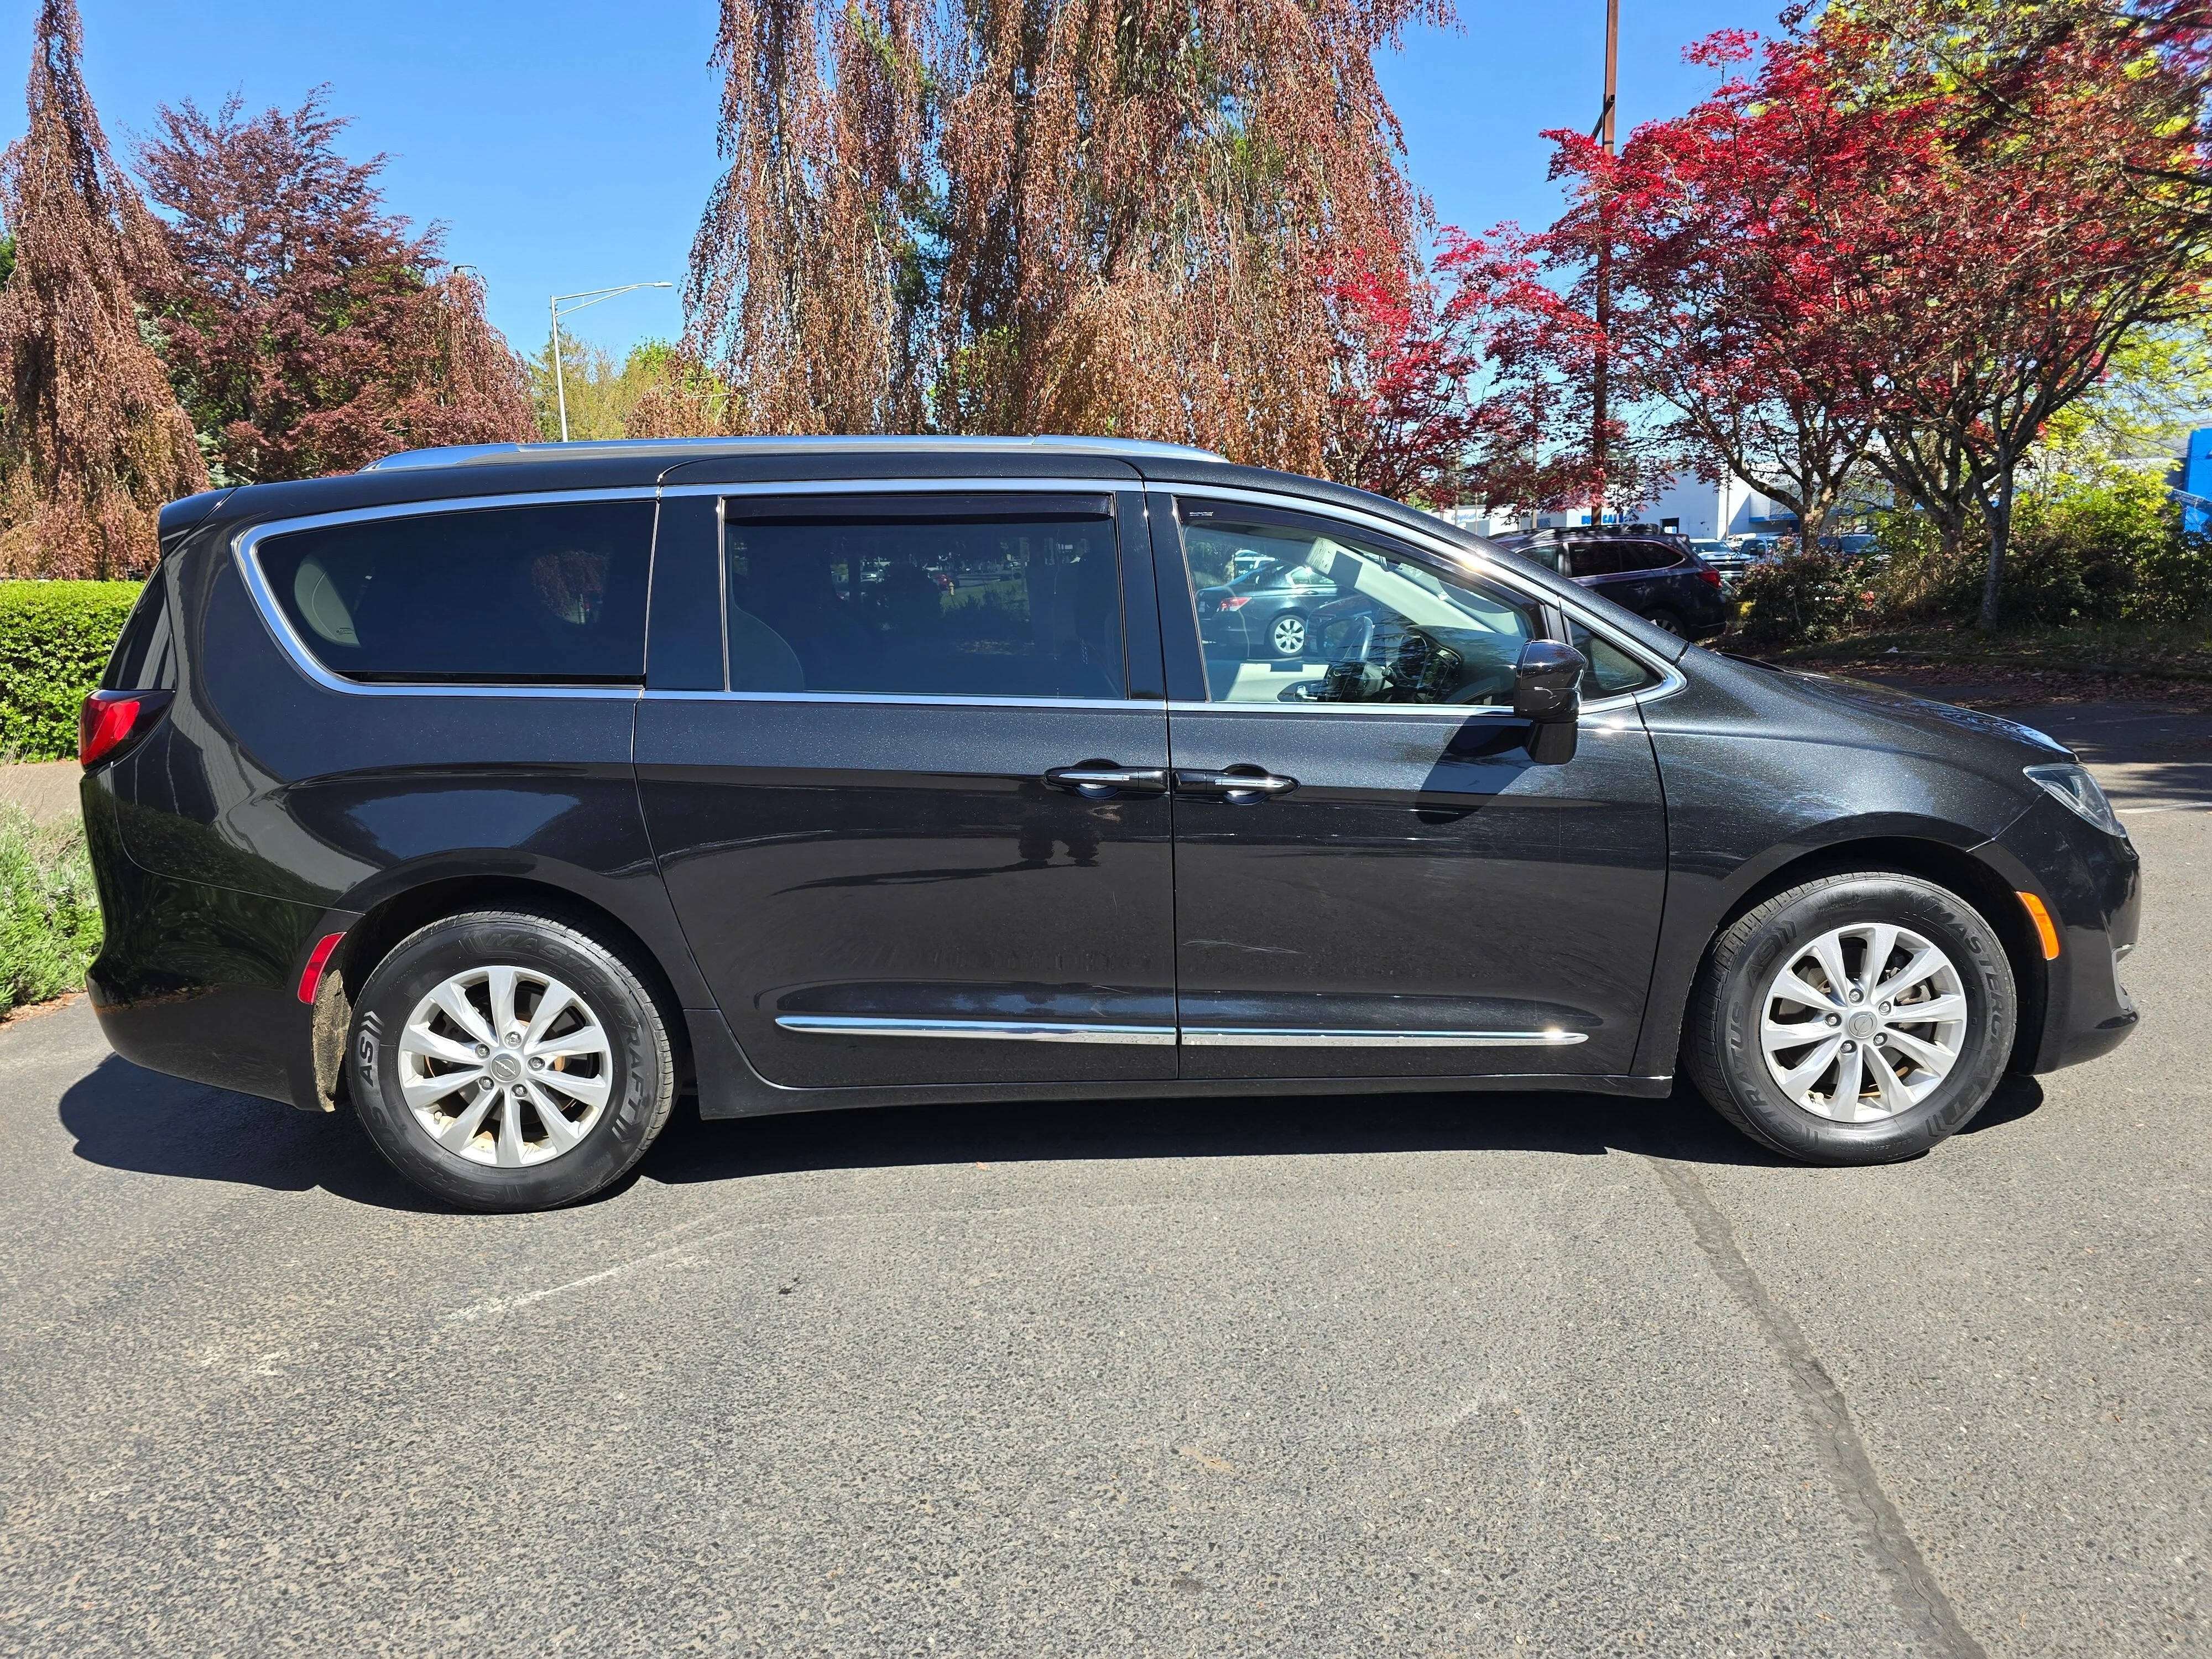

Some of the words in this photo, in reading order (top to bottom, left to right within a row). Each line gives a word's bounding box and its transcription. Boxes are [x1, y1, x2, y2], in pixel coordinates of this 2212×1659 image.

[1746, 938, 1776, 988] AS
[359, 1036, 375, 1088] AS
[1730, 1001, 1801, 1142] STRATUS
